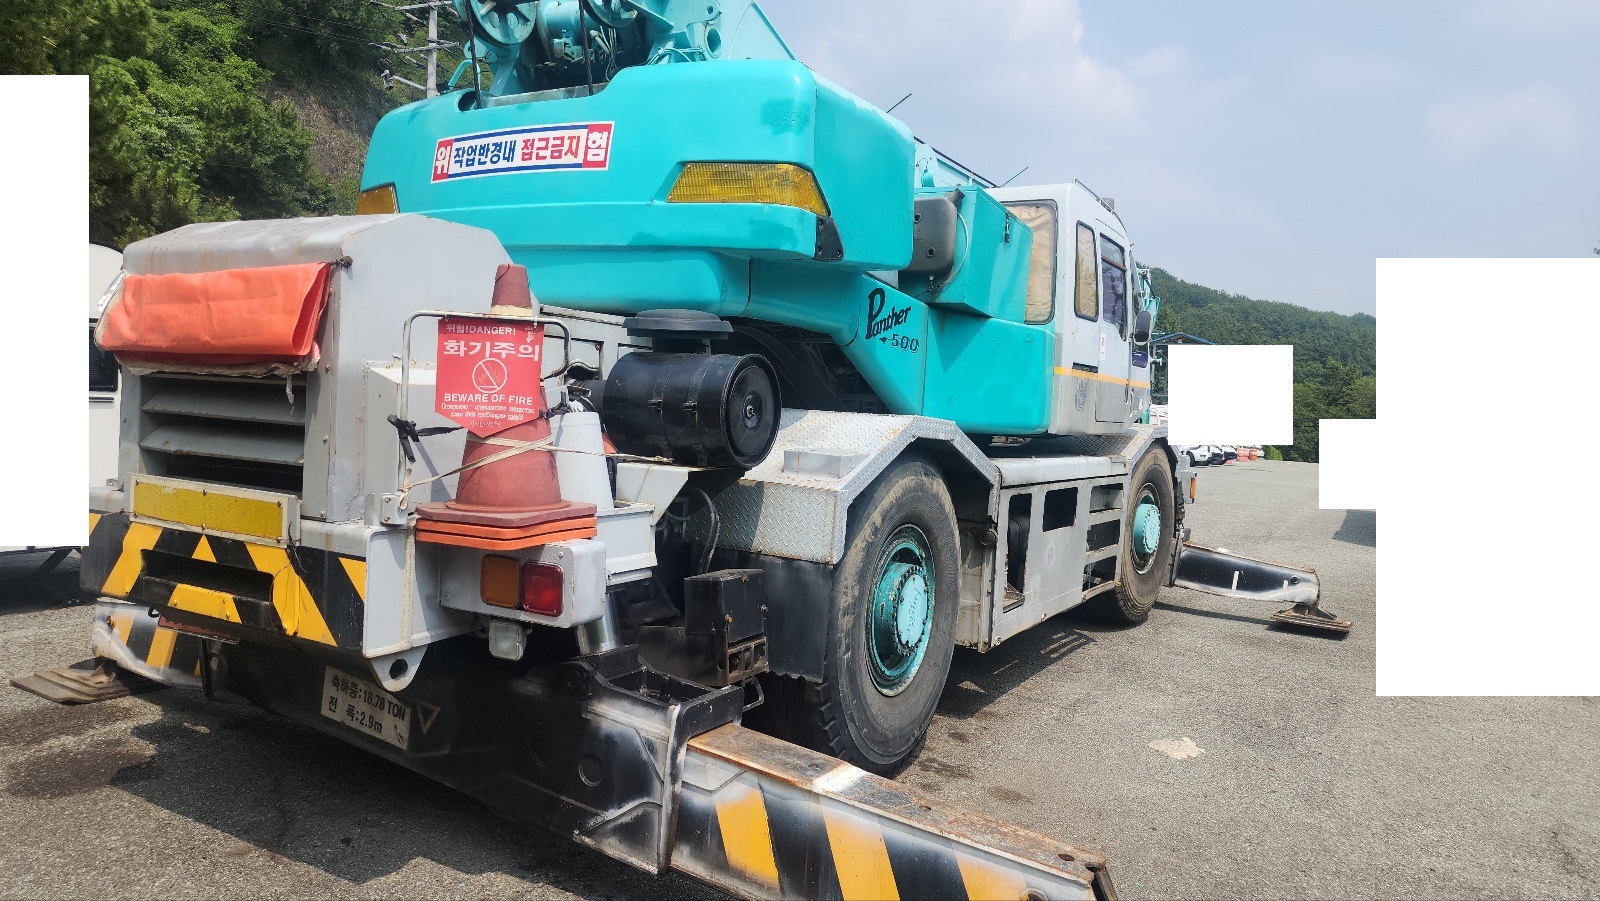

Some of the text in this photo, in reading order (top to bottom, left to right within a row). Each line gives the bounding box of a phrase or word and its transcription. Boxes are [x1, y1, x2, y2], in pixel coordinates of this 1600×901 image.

[435, 131, 608, 175] 위 작업반경내 접근금지 험
[865, 287, 912, 339] Panther
[443, 339, 540, 362] 화기주의
[444, 393, 534, 406] BEWARE OF FIRE
[328, 695, 338, 713] 전
[387, 700, 406, 721] TON
